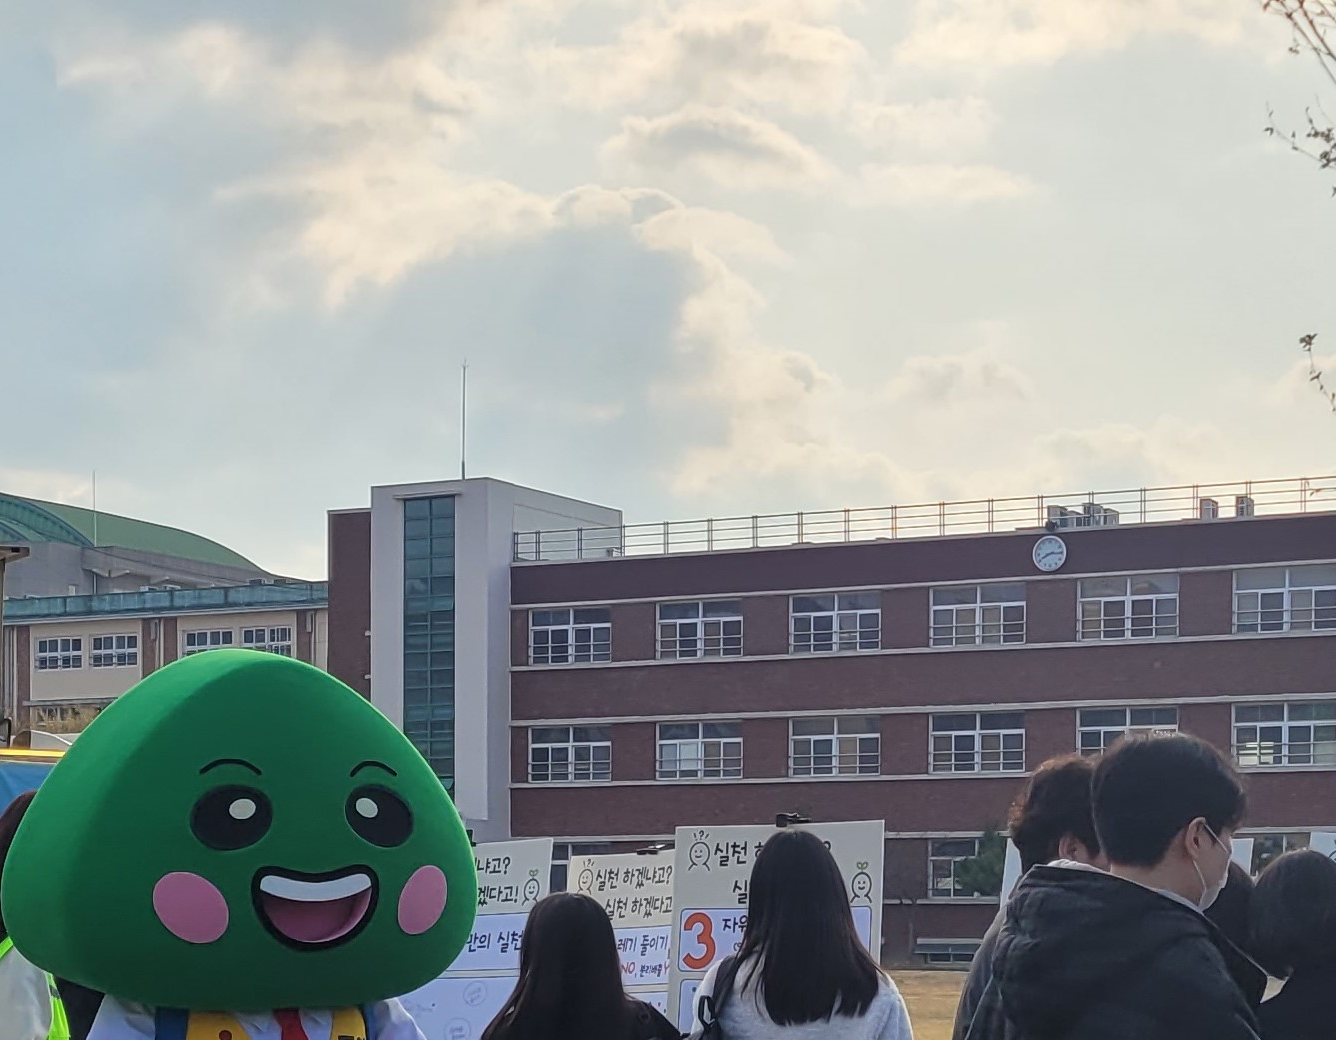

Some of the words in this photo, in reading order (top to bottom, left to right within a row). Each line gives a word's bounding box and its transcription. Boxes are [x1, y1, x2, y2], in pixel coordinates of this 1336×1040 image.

[476, 856, 511, 875] 냐고?
[714, 841, 747, 867] 실천
[596, 867, 619, 891] 실천
[623, 865, 673, 889] 하겠냐고?
[604, 897, 627, 921] 실천
[631, 896, 673, 919] 하겠다고
[683, 912, 716, 970] 3
